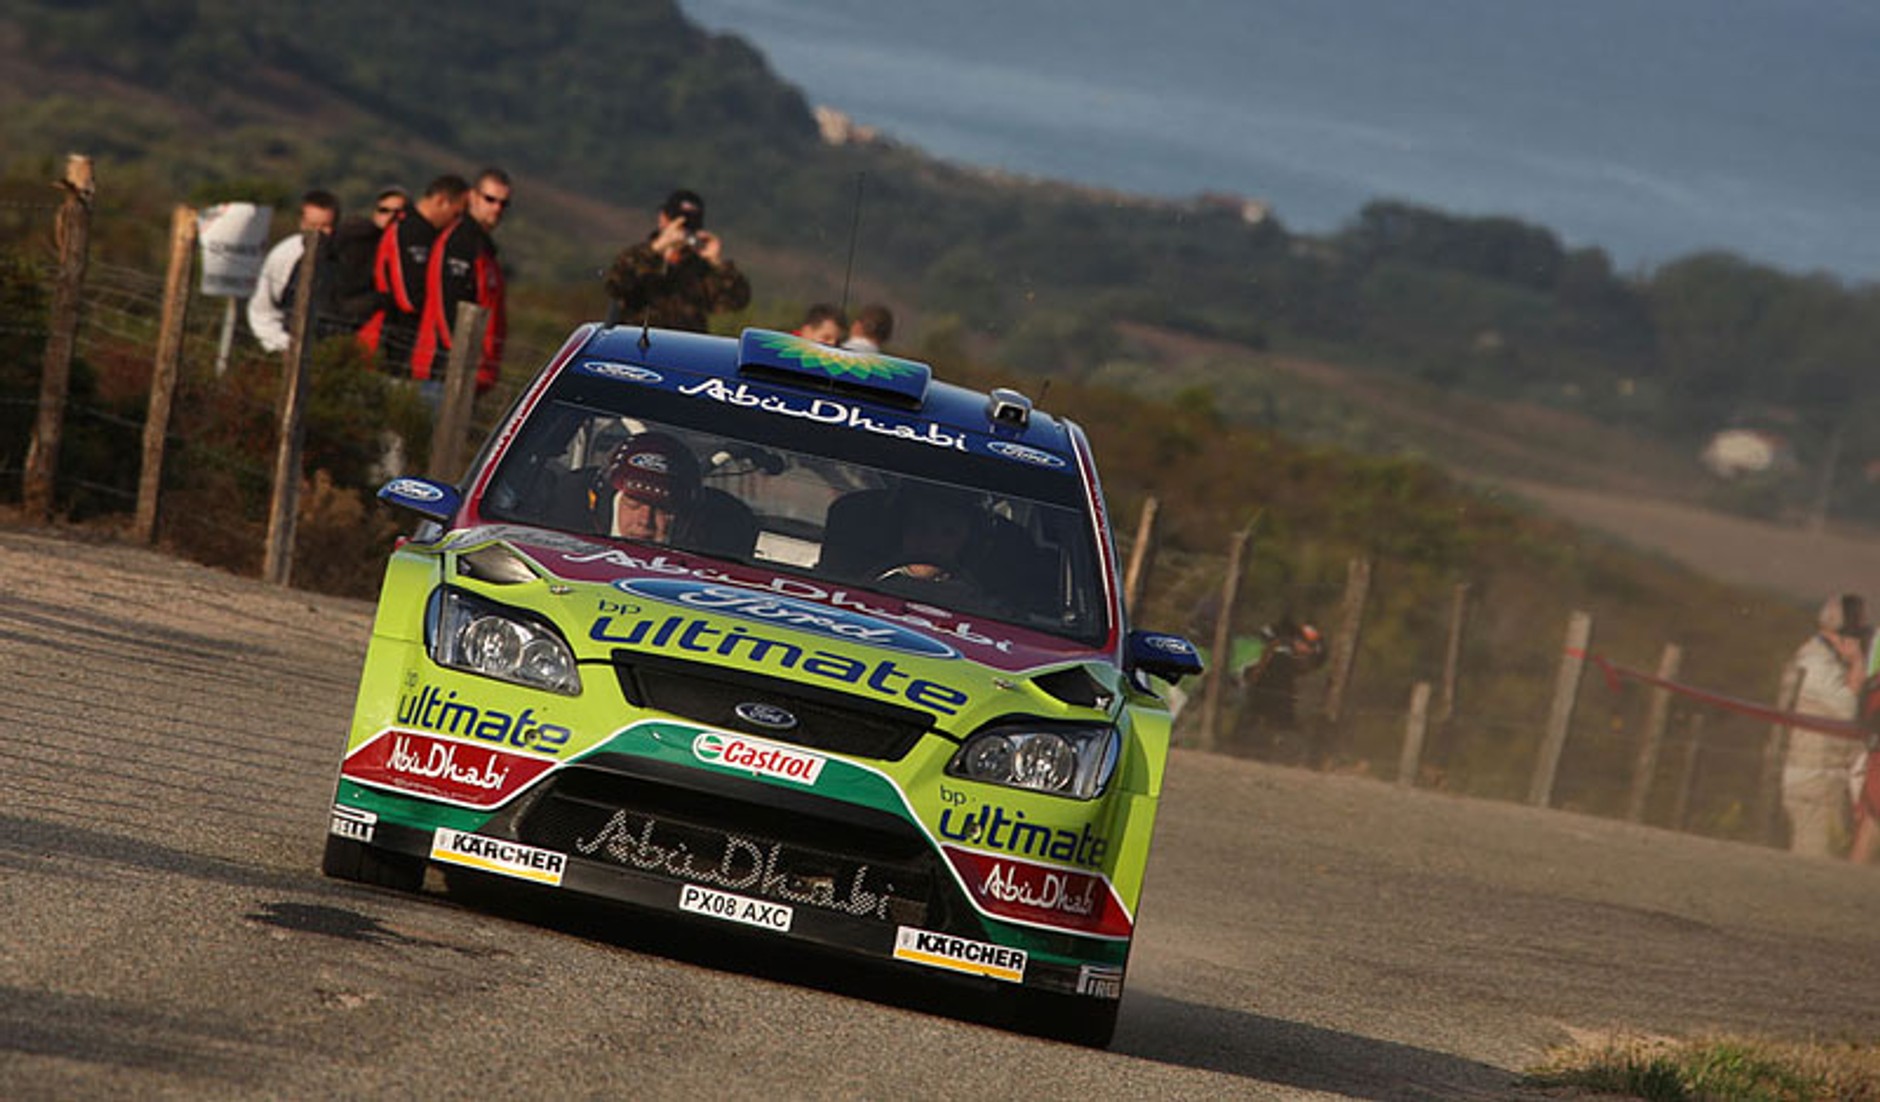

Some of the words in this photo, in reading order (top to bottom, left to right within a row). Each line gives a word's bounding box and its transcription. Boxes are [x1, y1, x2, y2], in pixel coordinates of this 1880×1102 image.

[598, 599, 642, 615] bp
[678, 588, 895, 644] Ford
[589, 616, 969, 716] ultimate
[396, 685, 572, 754] ultimate
[724, 741, 815, 779] Castrol
[940, 785, 967, 806] bp
[939, 805, 1108, 867] ultimate
[684, 887, 737, 916] PX08
[741, 901, 790, 928] AXC
